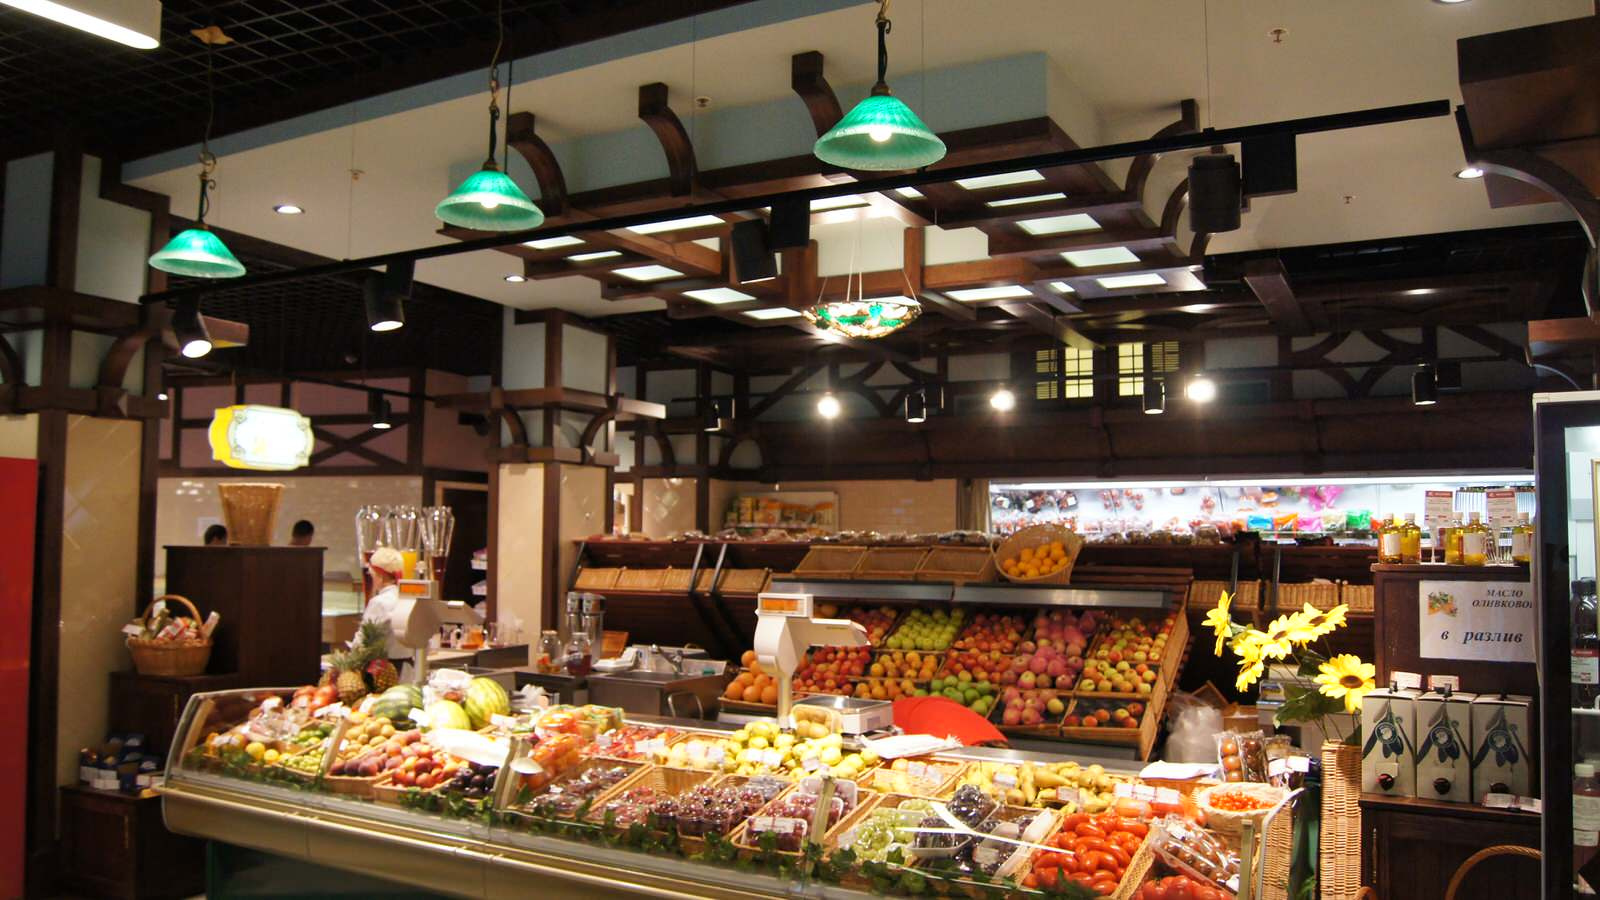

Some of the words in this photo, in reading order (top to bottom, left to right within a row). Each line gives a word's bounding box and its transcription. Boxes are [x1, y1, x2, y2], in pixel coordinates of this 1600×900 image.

[1487, 589, 1523, 598] МАСЛО
[1441, 630, 1450, 640] в
[1463, 631, 1523, 644] разлив
